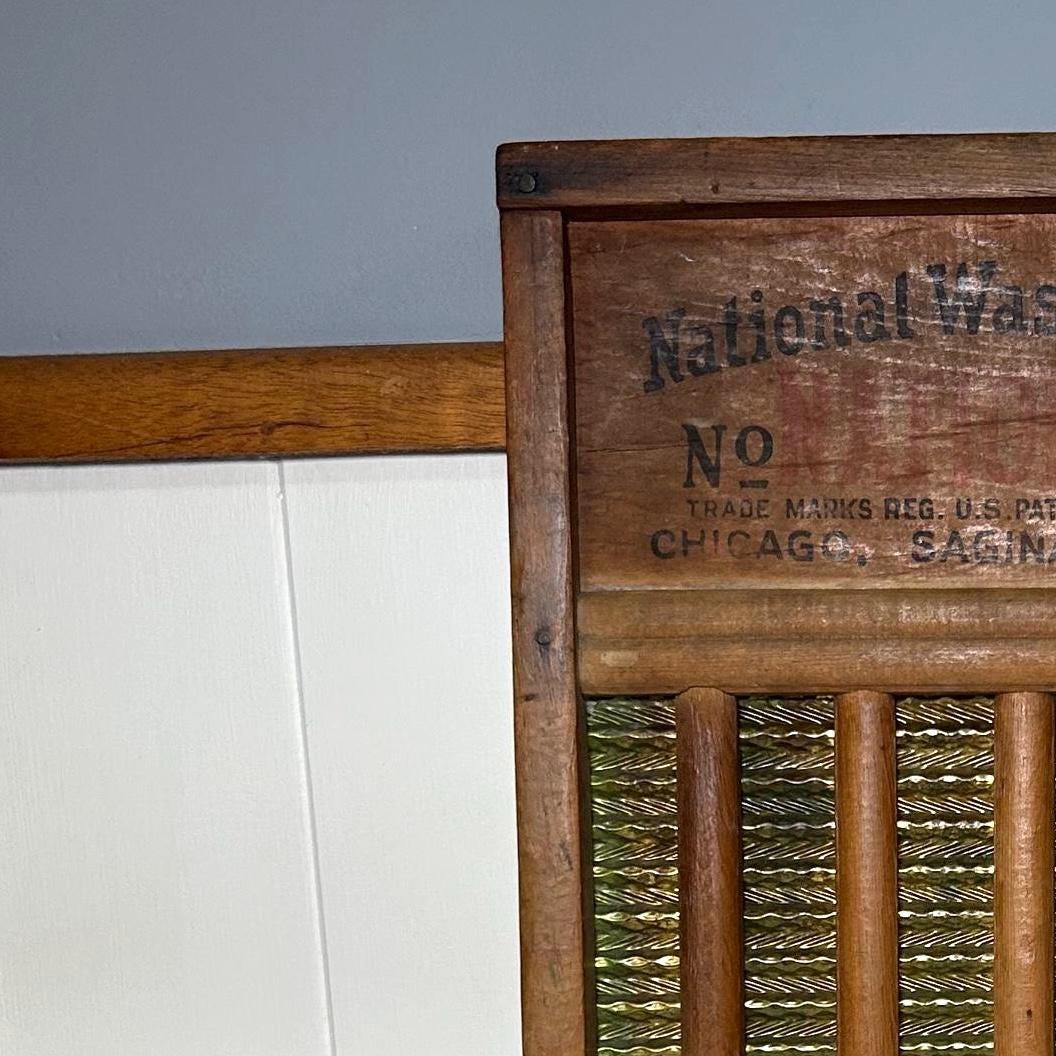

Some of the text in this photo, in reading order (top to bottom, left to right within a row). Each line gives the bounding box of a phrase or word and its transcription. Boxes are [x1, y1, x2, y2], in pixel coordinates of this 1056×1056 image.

[643, 270, 913, 392] National
[686, 499, 769, 518] TRADE
[785, 498, 872, 519] MARKS
[884, 498, 944, 520] REG.
